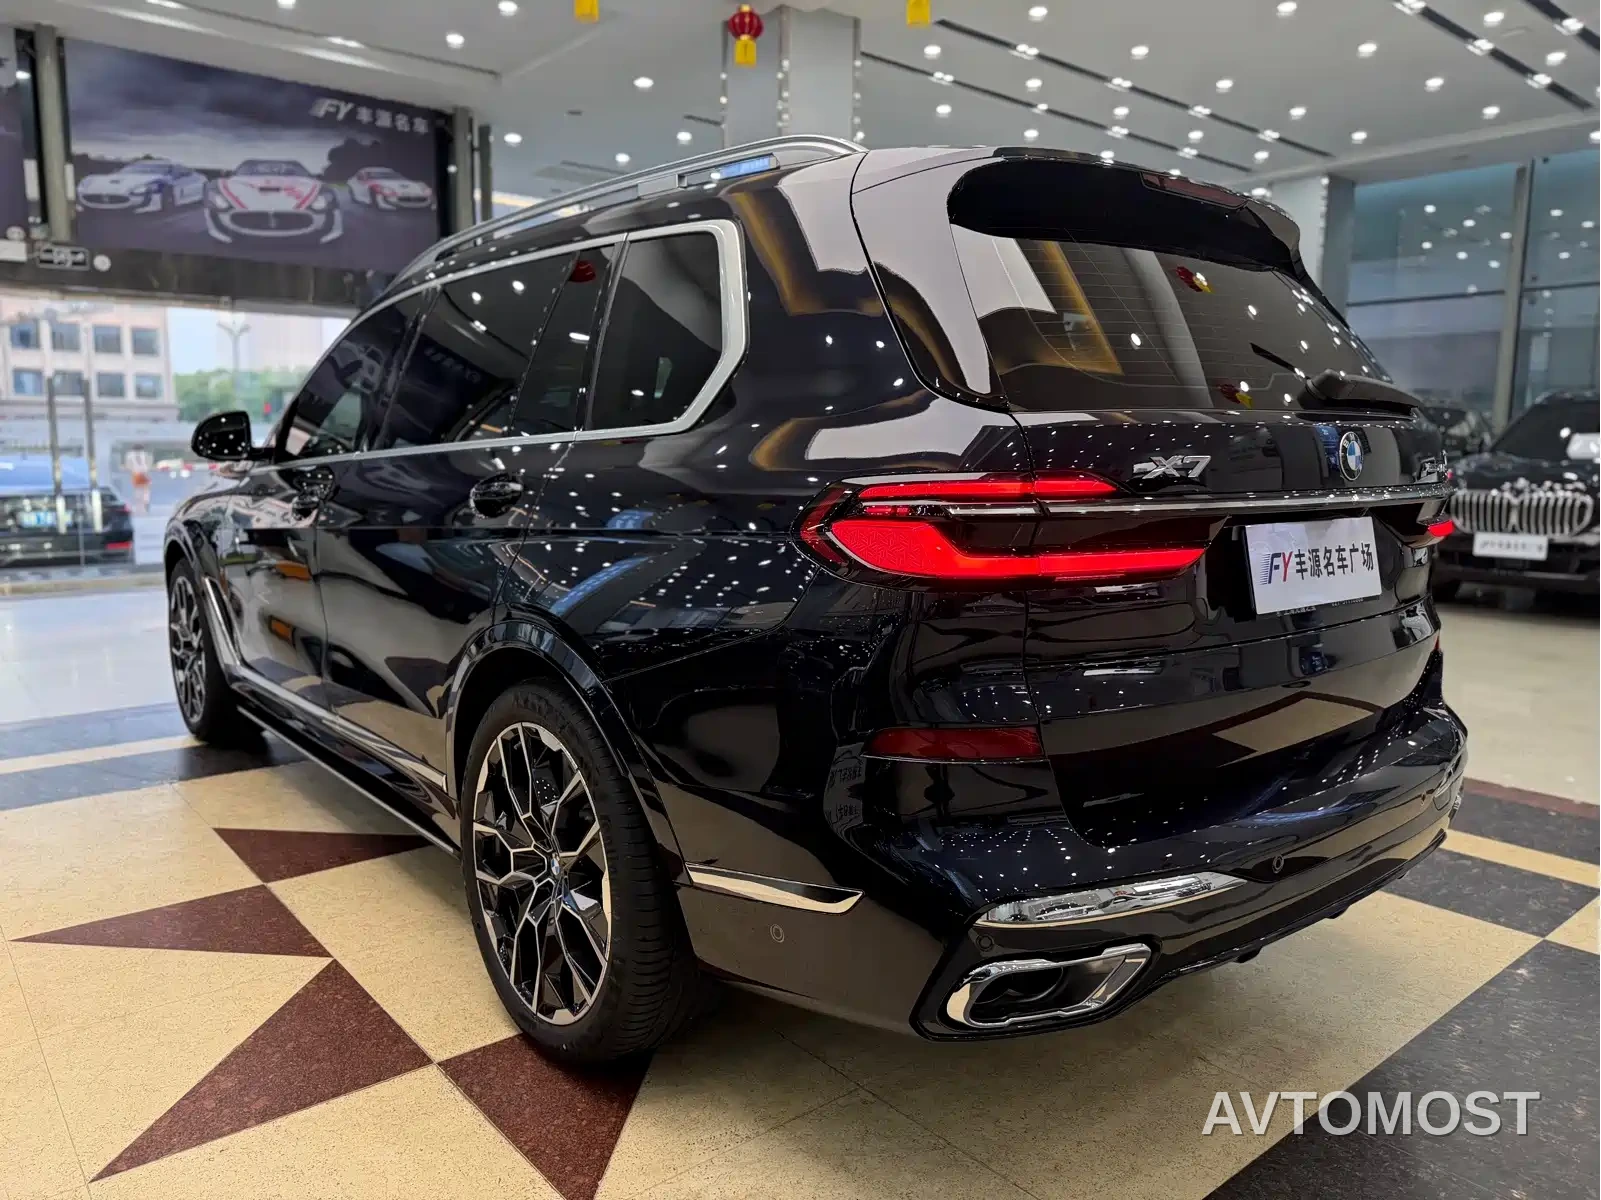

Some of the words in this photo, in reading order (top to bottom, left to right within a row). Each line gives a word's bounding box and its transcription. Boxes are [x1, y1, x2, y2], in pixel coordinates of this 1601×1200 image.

[1142, 455, 1211, 479] X7
[1266, 551, 1294, 584] FY
[1294, 542, 1374, 580] 丰源名车广场
